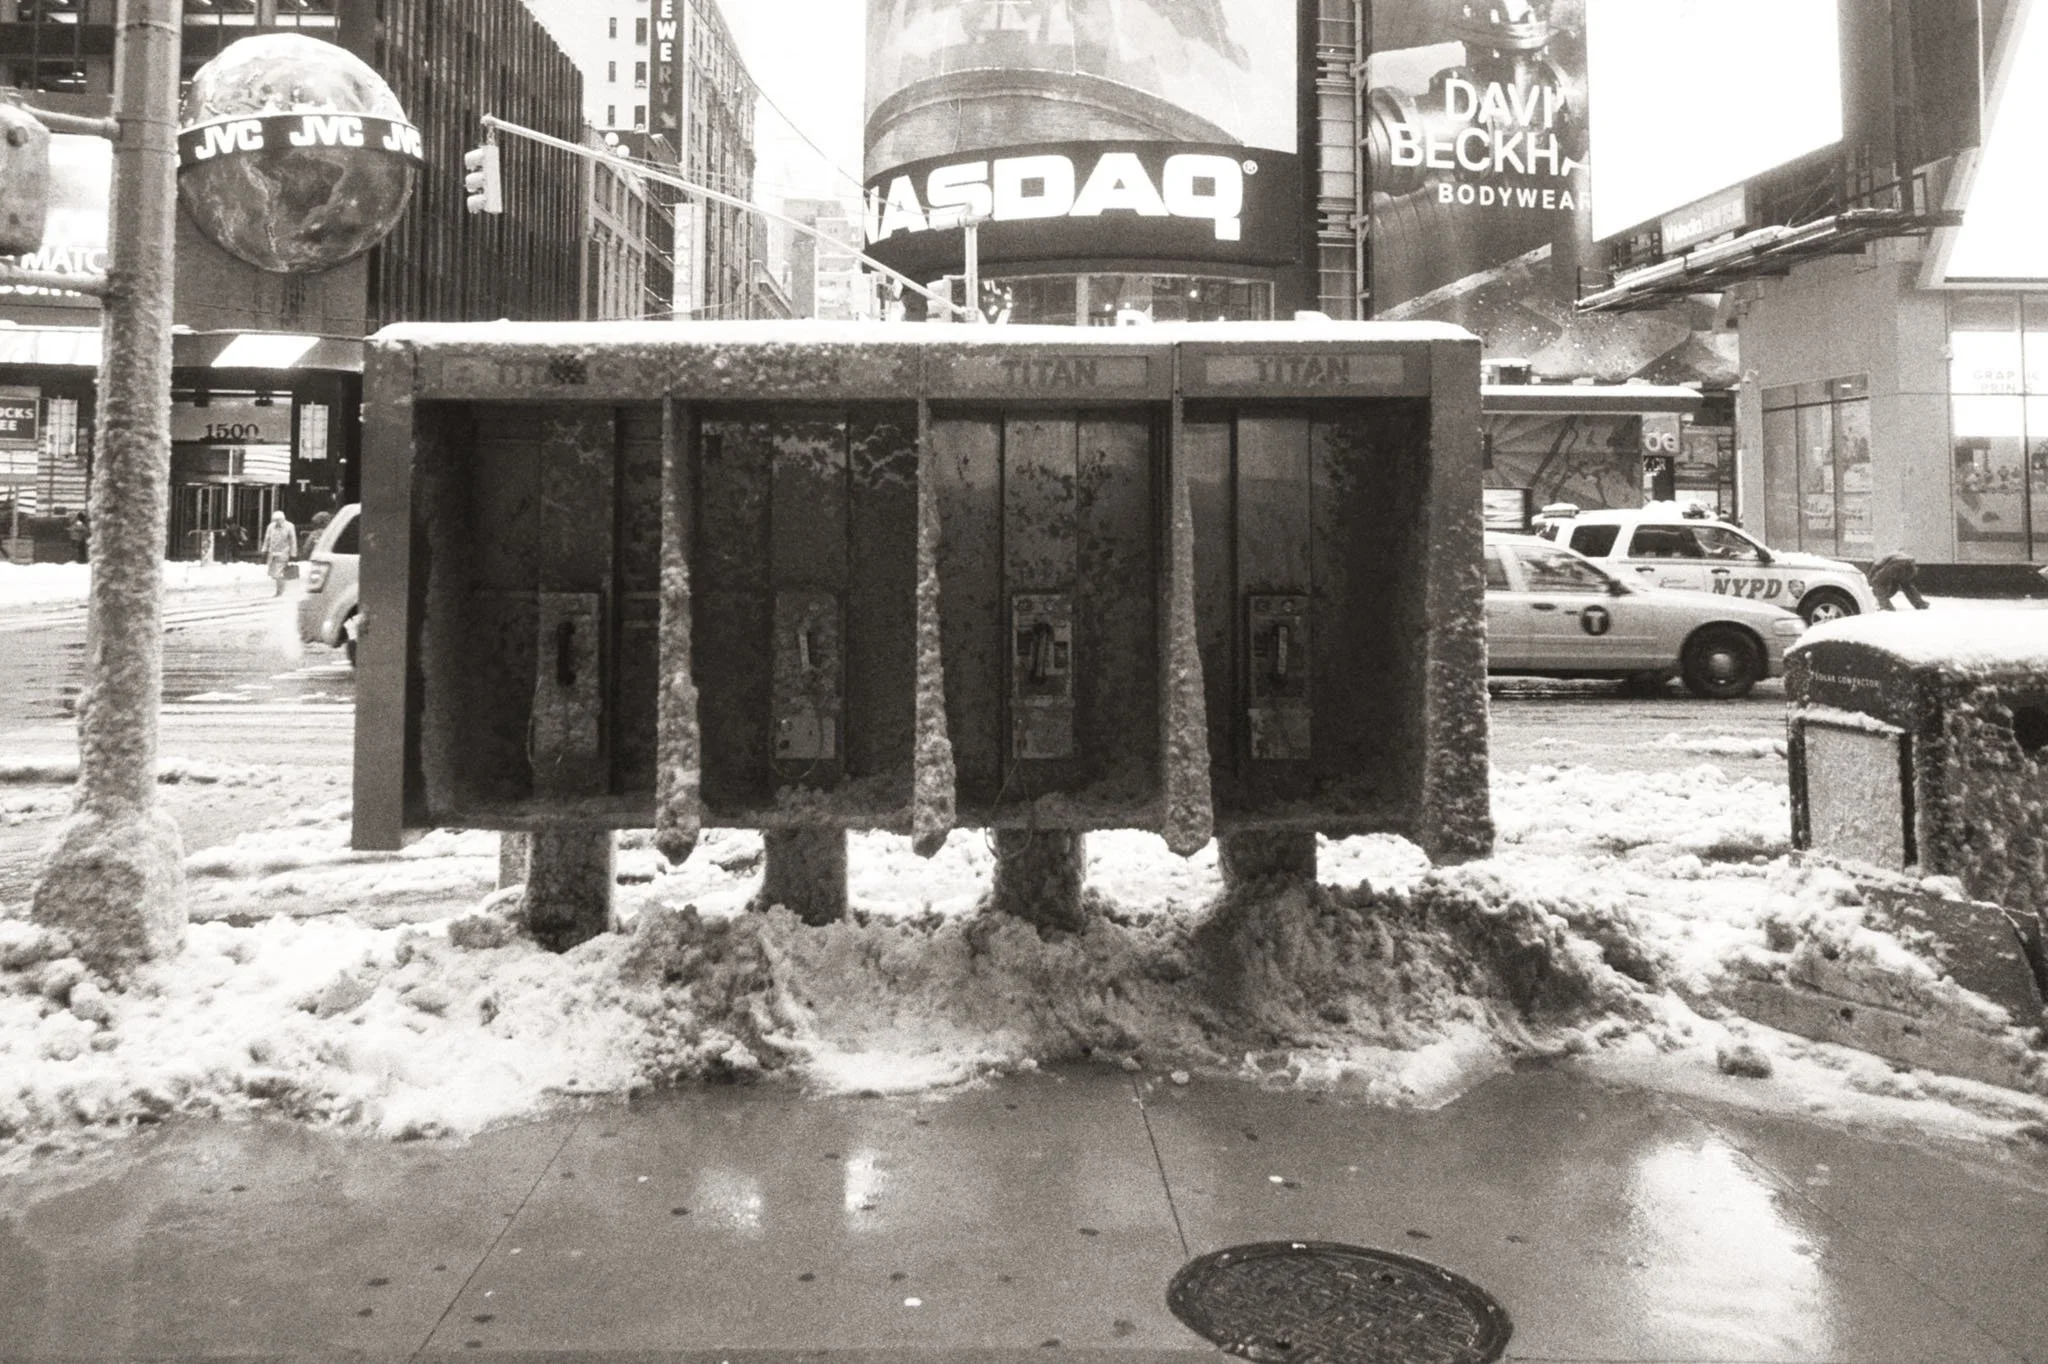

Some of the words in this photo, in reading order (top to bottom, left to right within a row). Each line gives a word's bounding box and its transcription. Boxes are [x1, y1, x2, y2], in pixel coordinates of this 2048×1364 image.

[1445, 78, 1566, 128] DAVI
[194, 119, 264, 160] JVC
[289, 115, 365, 147] JVC
[1001, 359, 1097, 387] TITAN
[1254, 356, 1350, 384] TITAN
[1973, 370, 2041, 381] GRAPIC
[1981, 383, 2033, 395] PRINS
[204, 423, 260, 440] 1500
[1712, 578, 1783, 600] NYPD
[1585, 610, 1605, 632] T
